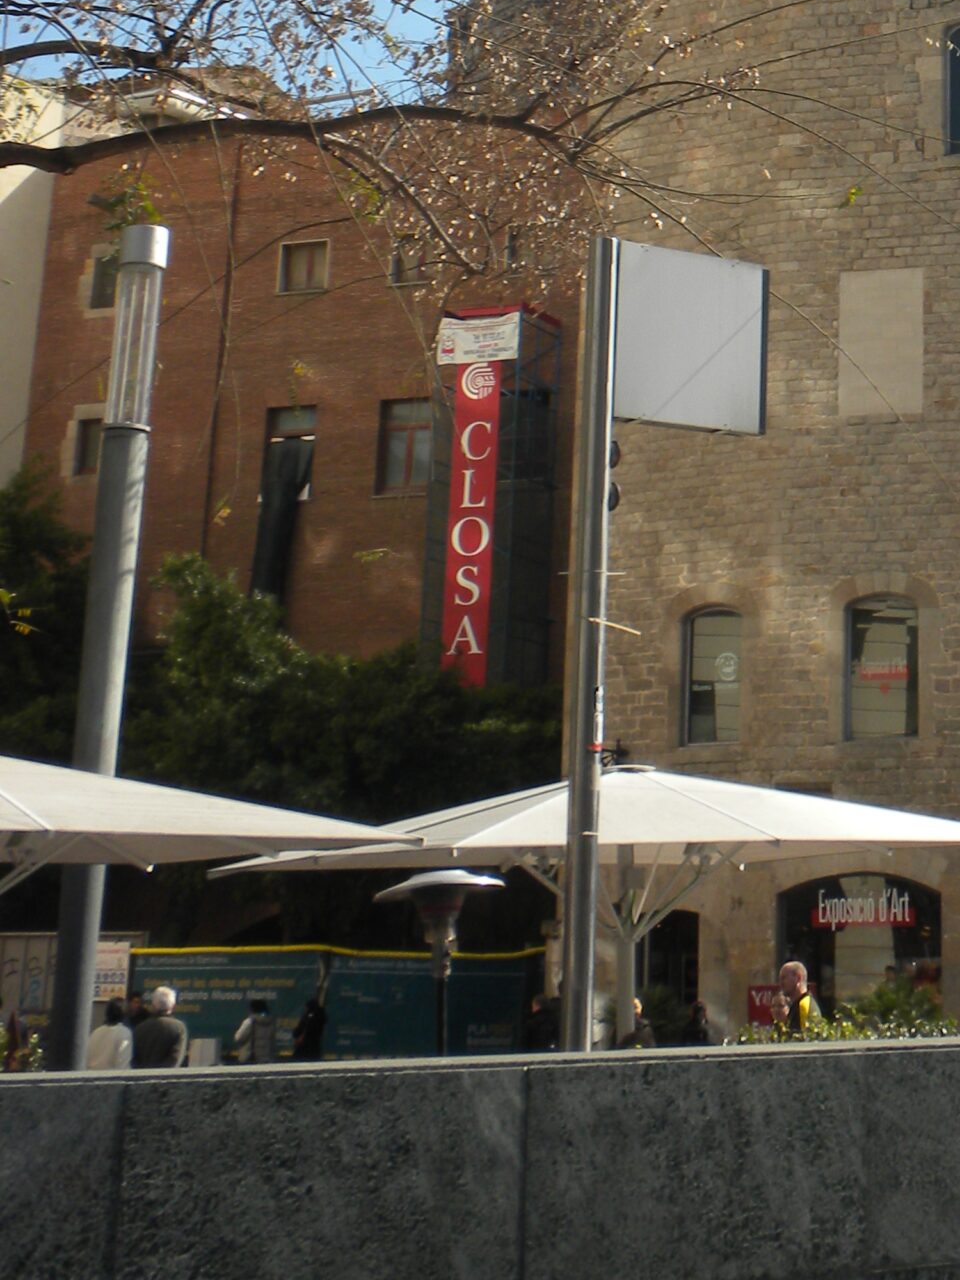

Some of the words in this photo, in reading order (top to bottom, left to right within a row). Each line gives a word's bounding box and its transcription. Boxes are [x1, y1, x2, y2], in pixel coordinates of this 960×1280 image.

[446, 421, 491, 656] CLOSA
[818, 889, 875, 931] Exposició
[879, 888, 910, 922] d'Art
